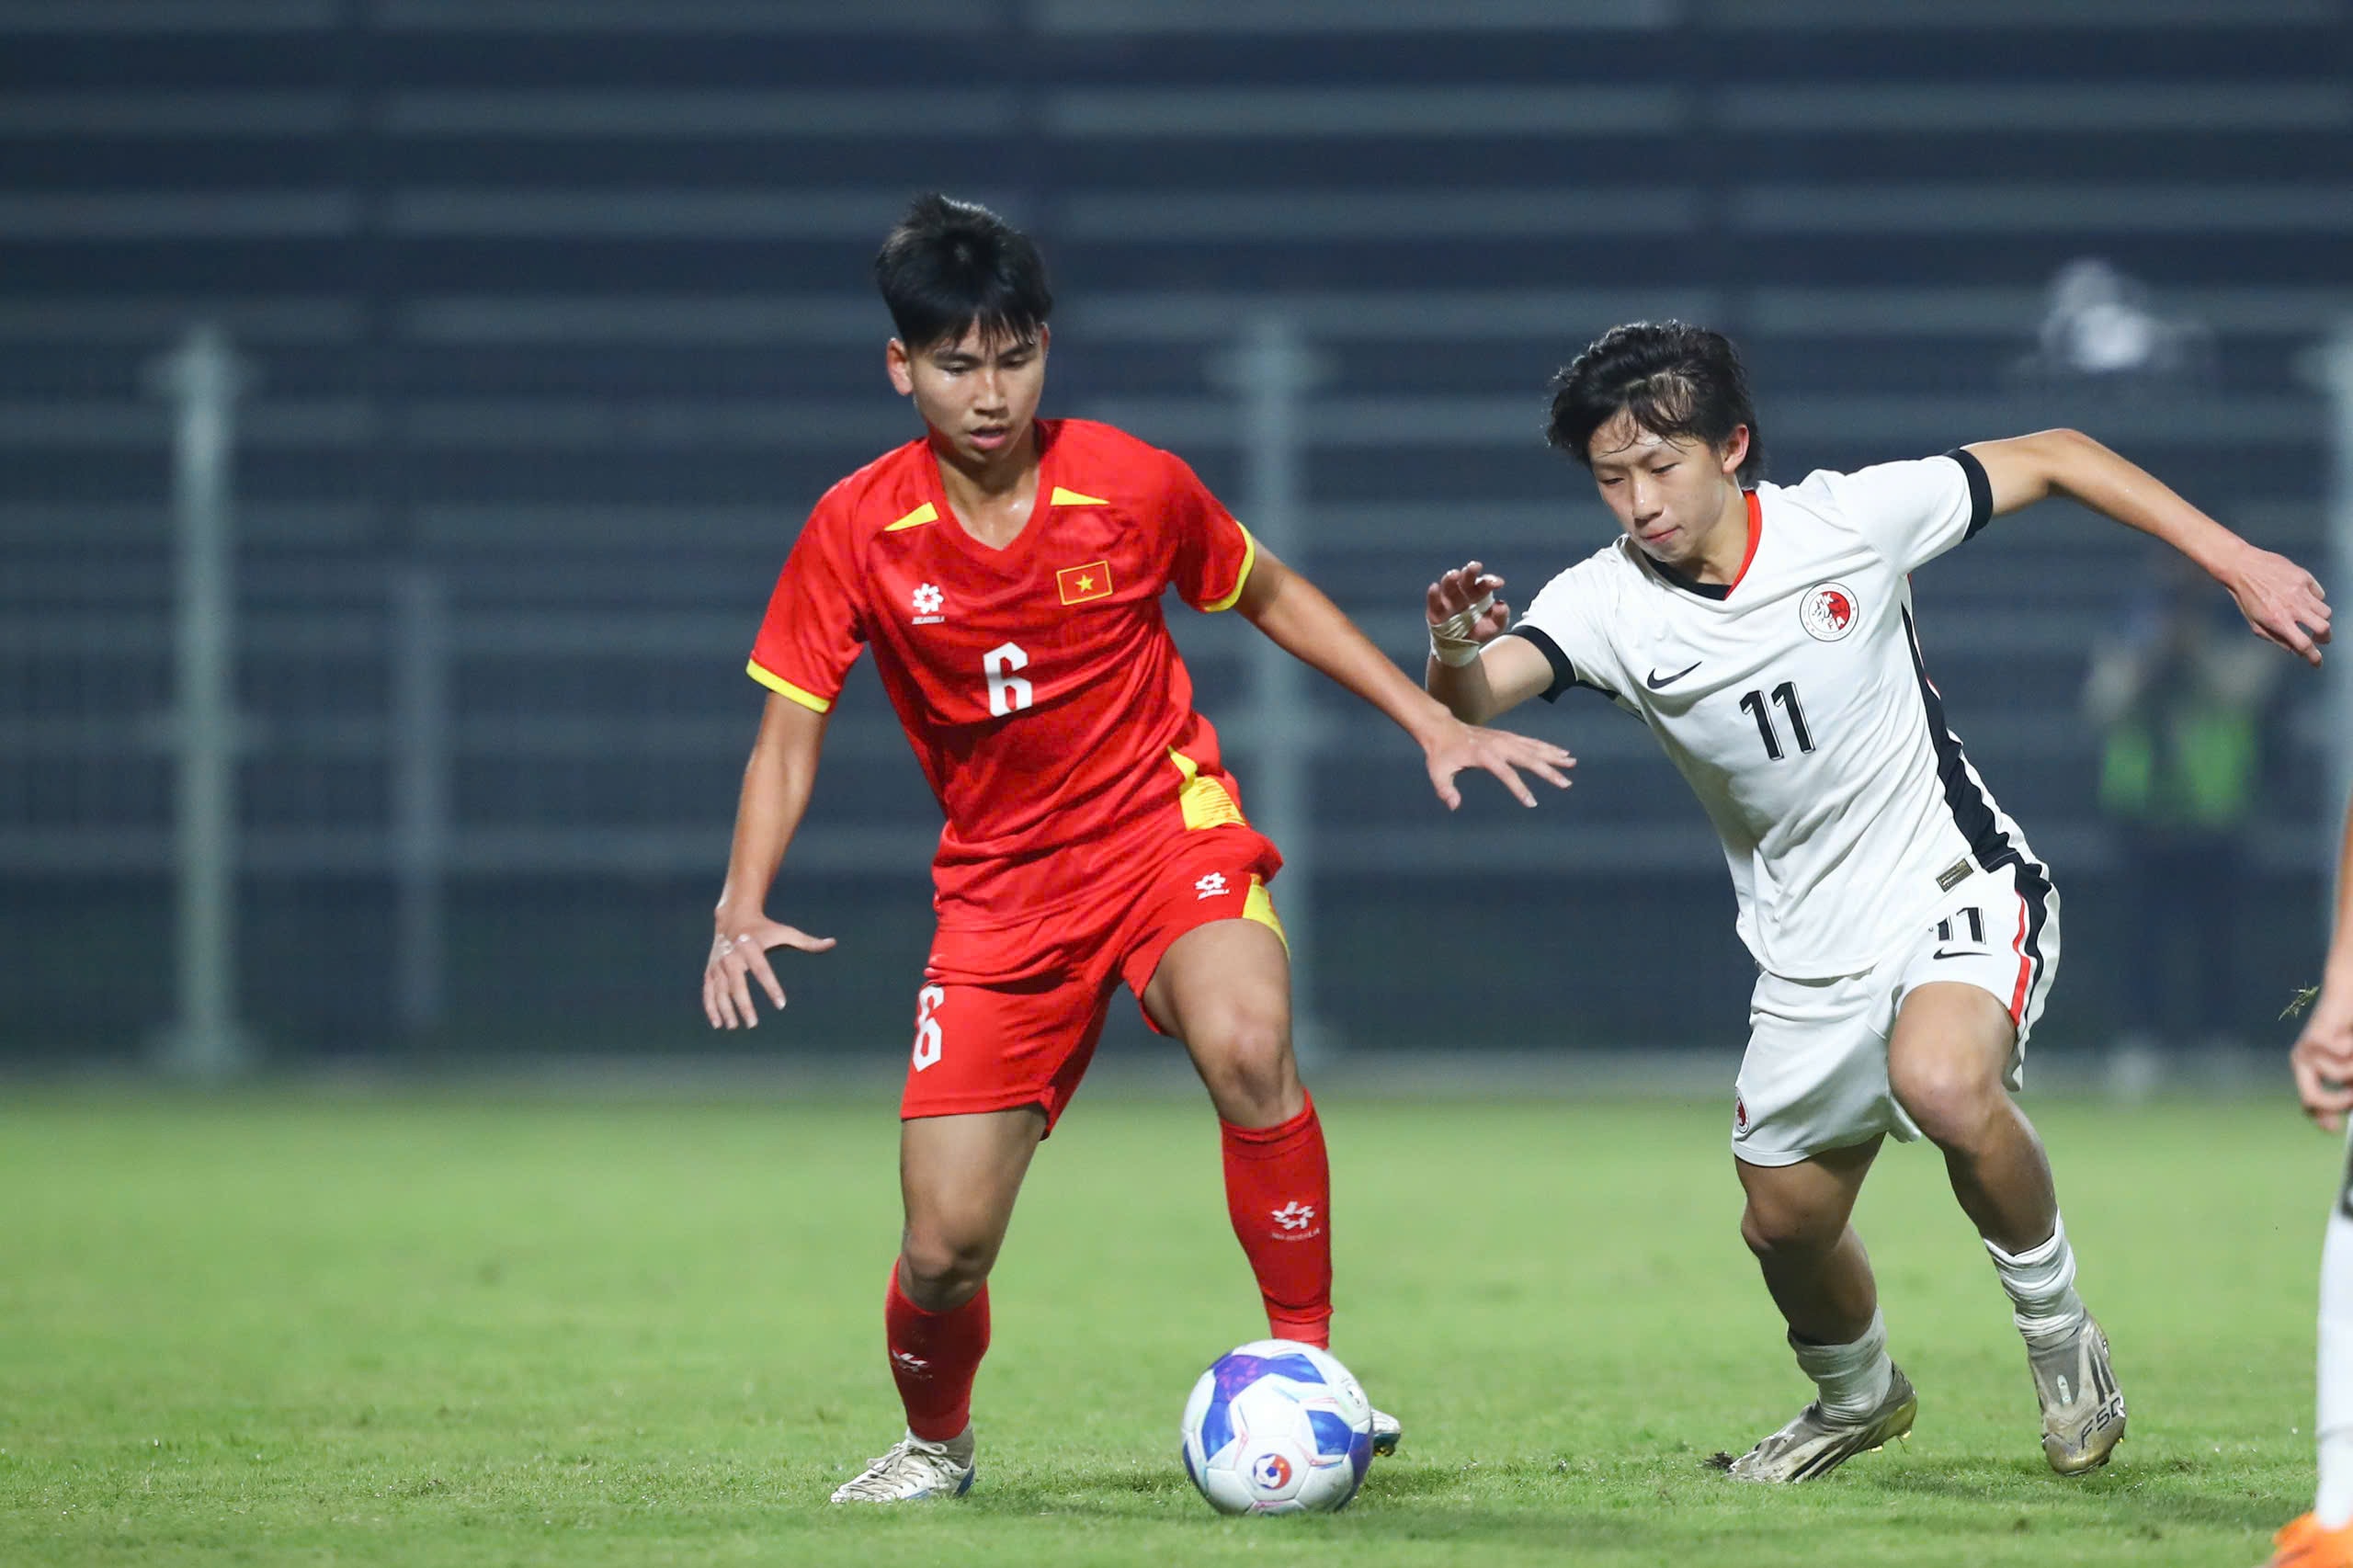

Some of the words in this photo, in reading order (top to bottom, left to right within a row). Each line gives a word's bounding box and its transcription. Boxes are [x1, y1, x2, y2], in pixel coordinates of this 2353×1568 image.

[983, 642, 1032, 717] 6
[1739, 681, 1816, 761] 11
[912, 984, 945, 1074] 6
